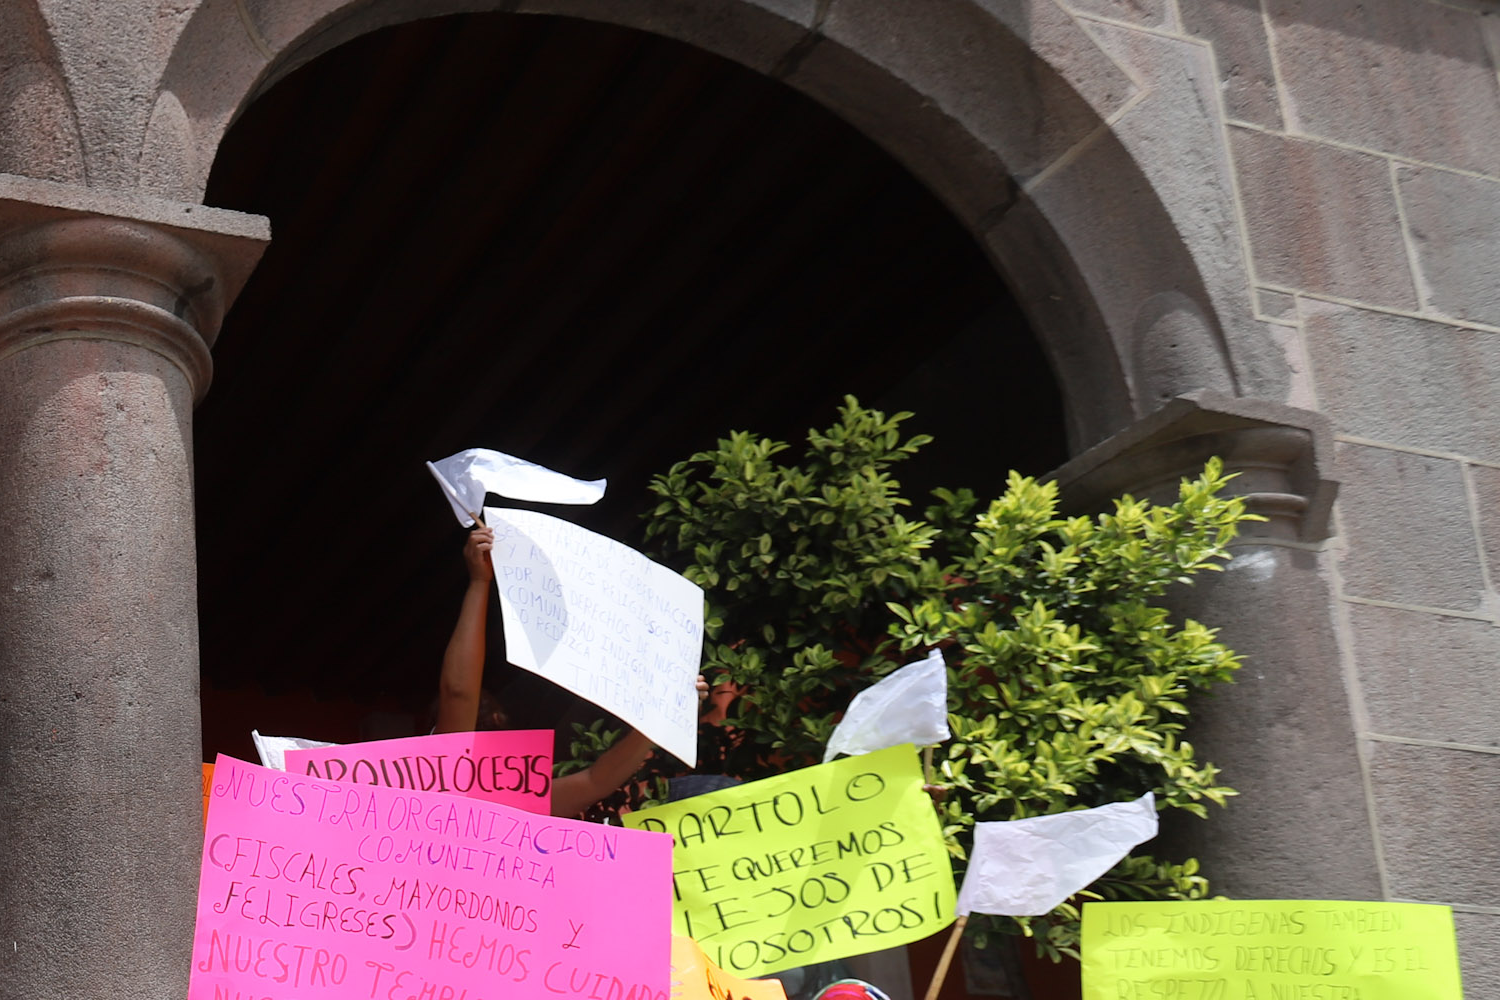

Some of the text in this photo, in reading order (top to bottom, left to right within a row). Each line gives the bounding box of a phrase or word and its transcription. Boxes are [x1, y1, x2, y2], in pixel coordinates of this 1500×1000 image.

[503, 565, 533, 583] POR
[542, 575, 563, 598] LOS
[508, 585, 595, 642] COMUNIDAD
[214, 766, 619, 862] NUESTRA ORGANIZACION
[358, 834, 556, 888] COMUNITARIA
[732, 821, 904, 882] QUEREMOS
[864, 852, 938, 892] DE
[213, 881, 417, 951] FELIGRESES)
[428, 919, 531, 982] HEMOS
[562, 919, 584, 950] Y
[1102, 909, 1403, 937] LOS INDIGENAS TAMBIEN
[198, 930, 348, 988] NUESTRO
[1107, 945, 1429, 975] TENEMOS DERECHOS Y ES EL
